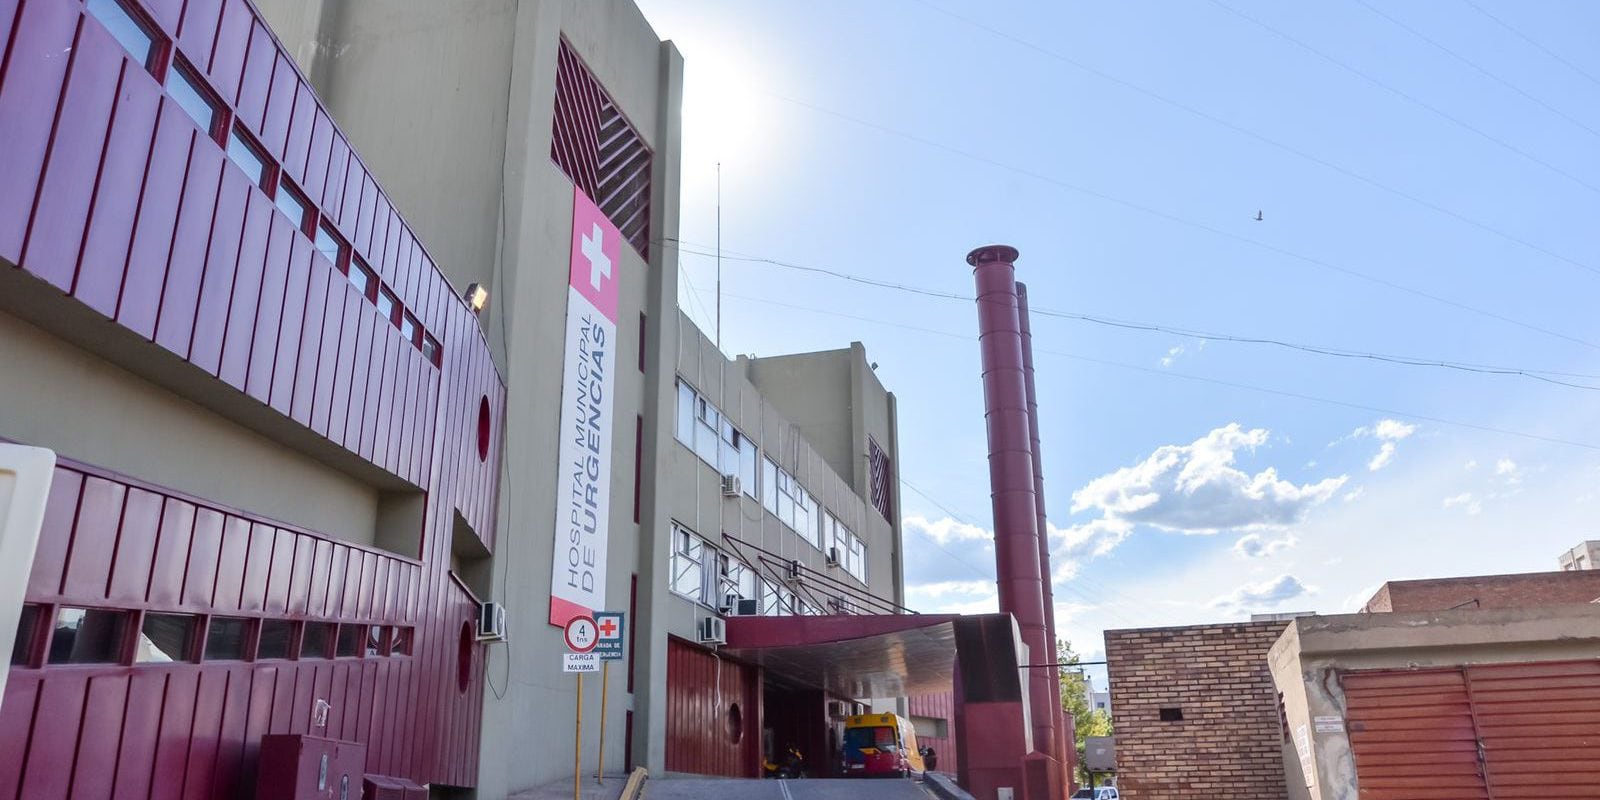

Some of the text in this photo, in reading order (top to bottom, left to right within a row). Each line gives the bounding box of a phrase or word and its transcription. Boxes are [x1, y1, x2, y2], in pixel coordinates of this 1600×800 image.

[567, 314, 591, 588] HOSPITAL MUNICIPAL
[582, 323, 605, 593] DE URGENCIAS
[579, 625, 585, 636] 4
